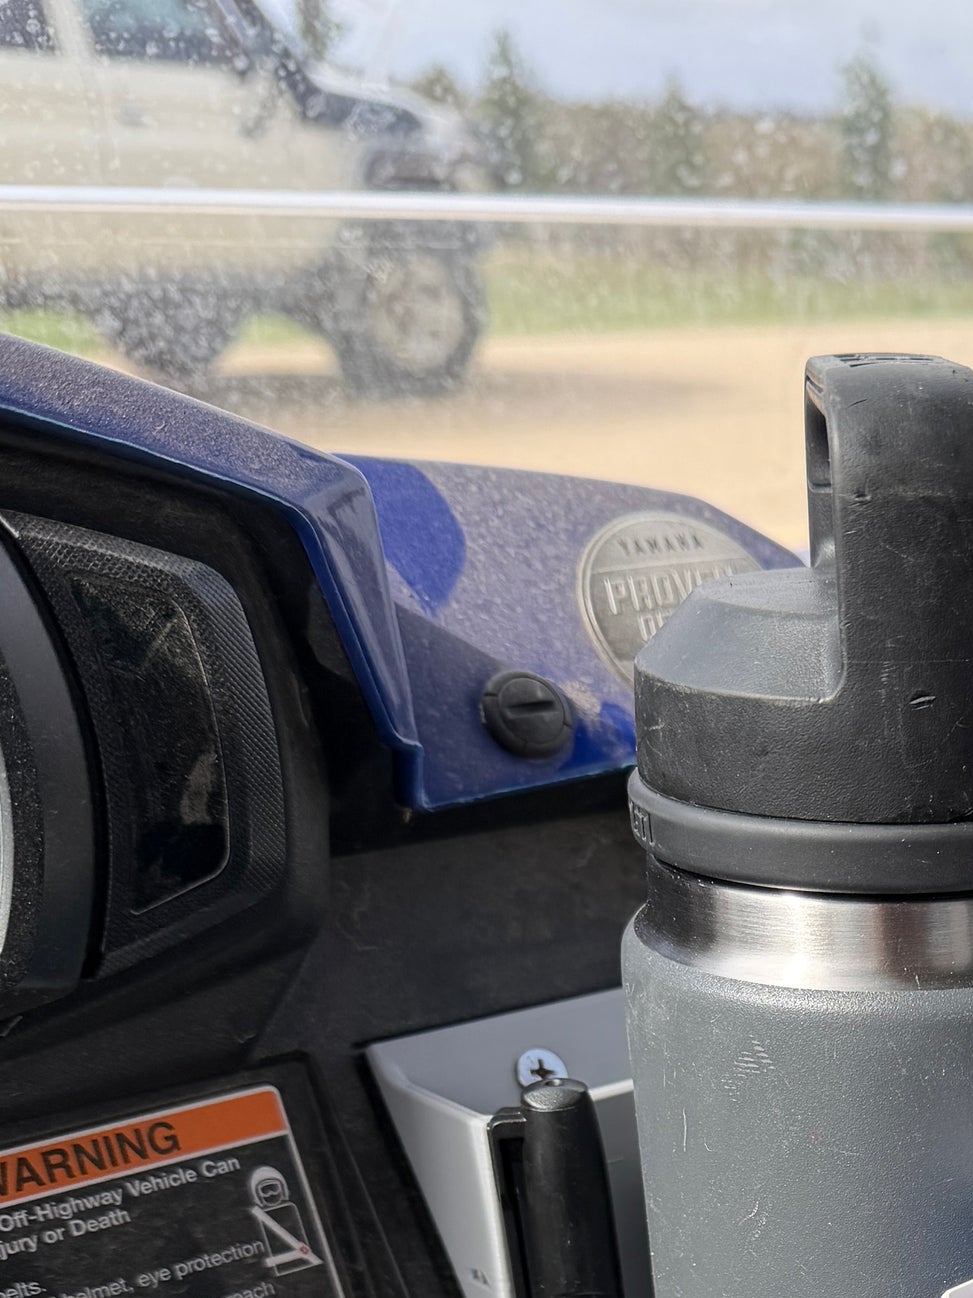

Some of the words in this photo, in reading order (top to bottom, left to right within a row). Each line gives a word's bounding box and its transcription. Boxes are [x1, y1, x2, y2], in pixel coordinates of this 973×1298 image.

[0, 1188, 122, 1232] Off-Highway
[126, 1168, 198, 1197] Vehicle
[201, 1157, 240, 1177] Can
[0, 1234, 38, 1260] jury
[42, 1227, 65, 1244] or
[69, 1208, 131, 1237] Death
[137, 1268, 171, 1288] eye
[174, 1240, 265, 1280] protection
